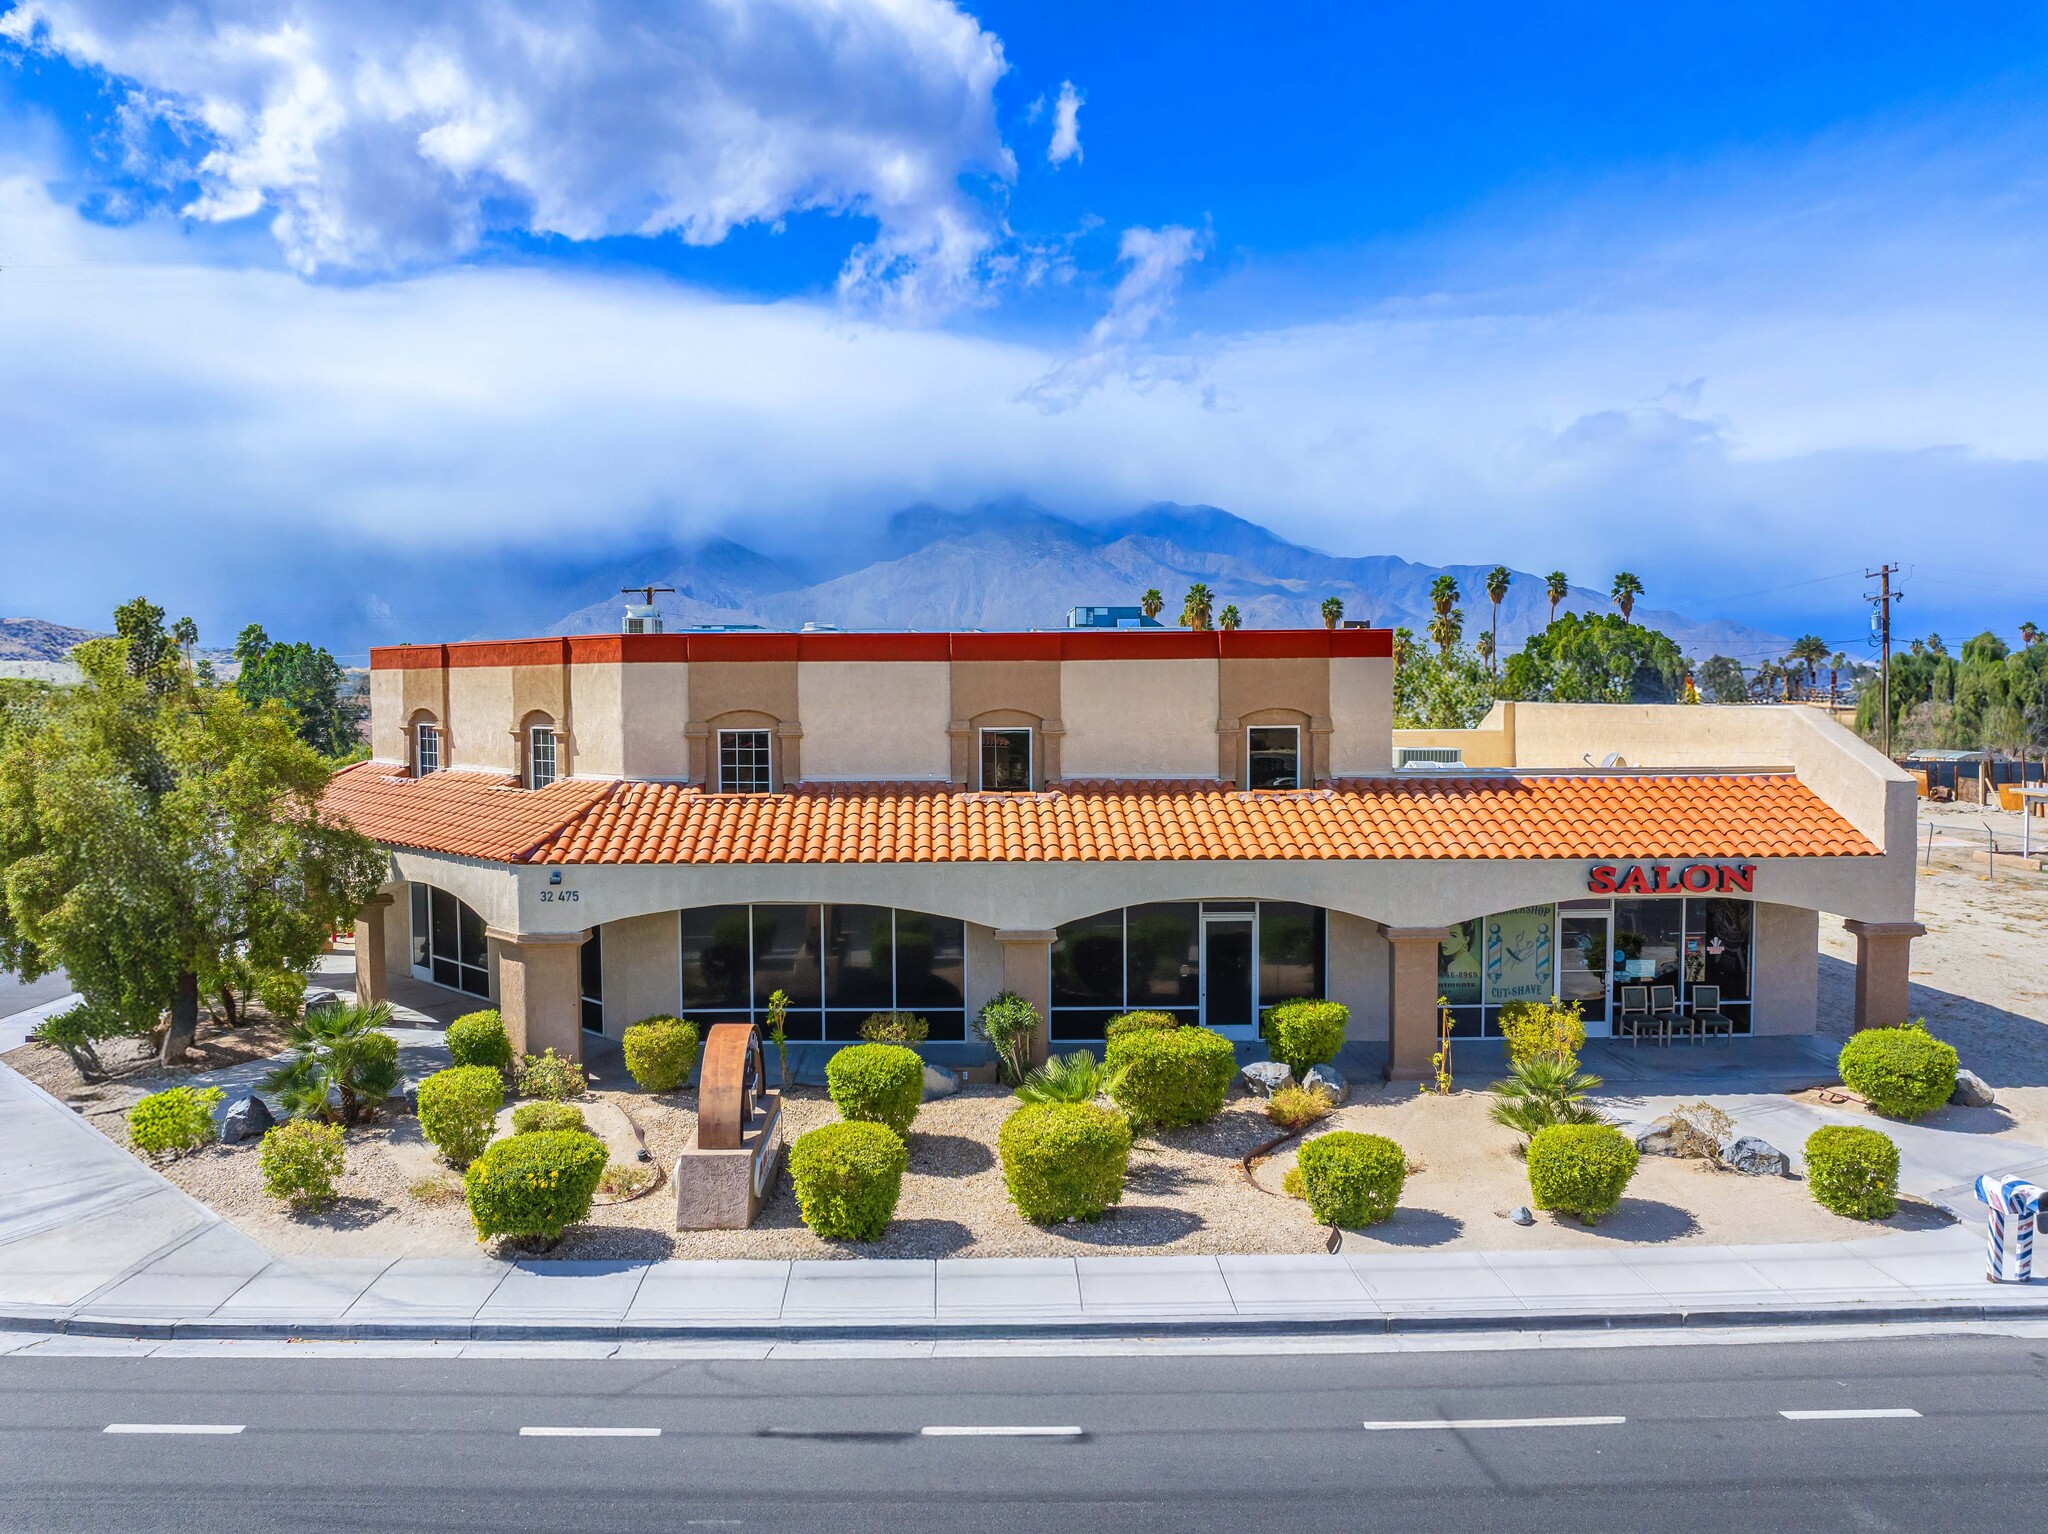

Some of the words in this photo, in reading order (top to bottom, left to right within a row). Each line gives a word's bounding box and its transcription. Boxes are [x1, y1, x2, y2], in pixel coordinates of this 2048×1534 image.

[1588, 864, 1757, 894] SALON
[540, 891, 553, 902] 32
[558, 891, 579, 902] 475
[1491, 905, 1551, 918] ERSHOP
[1511, 984, 1542, 997] SHAVE
